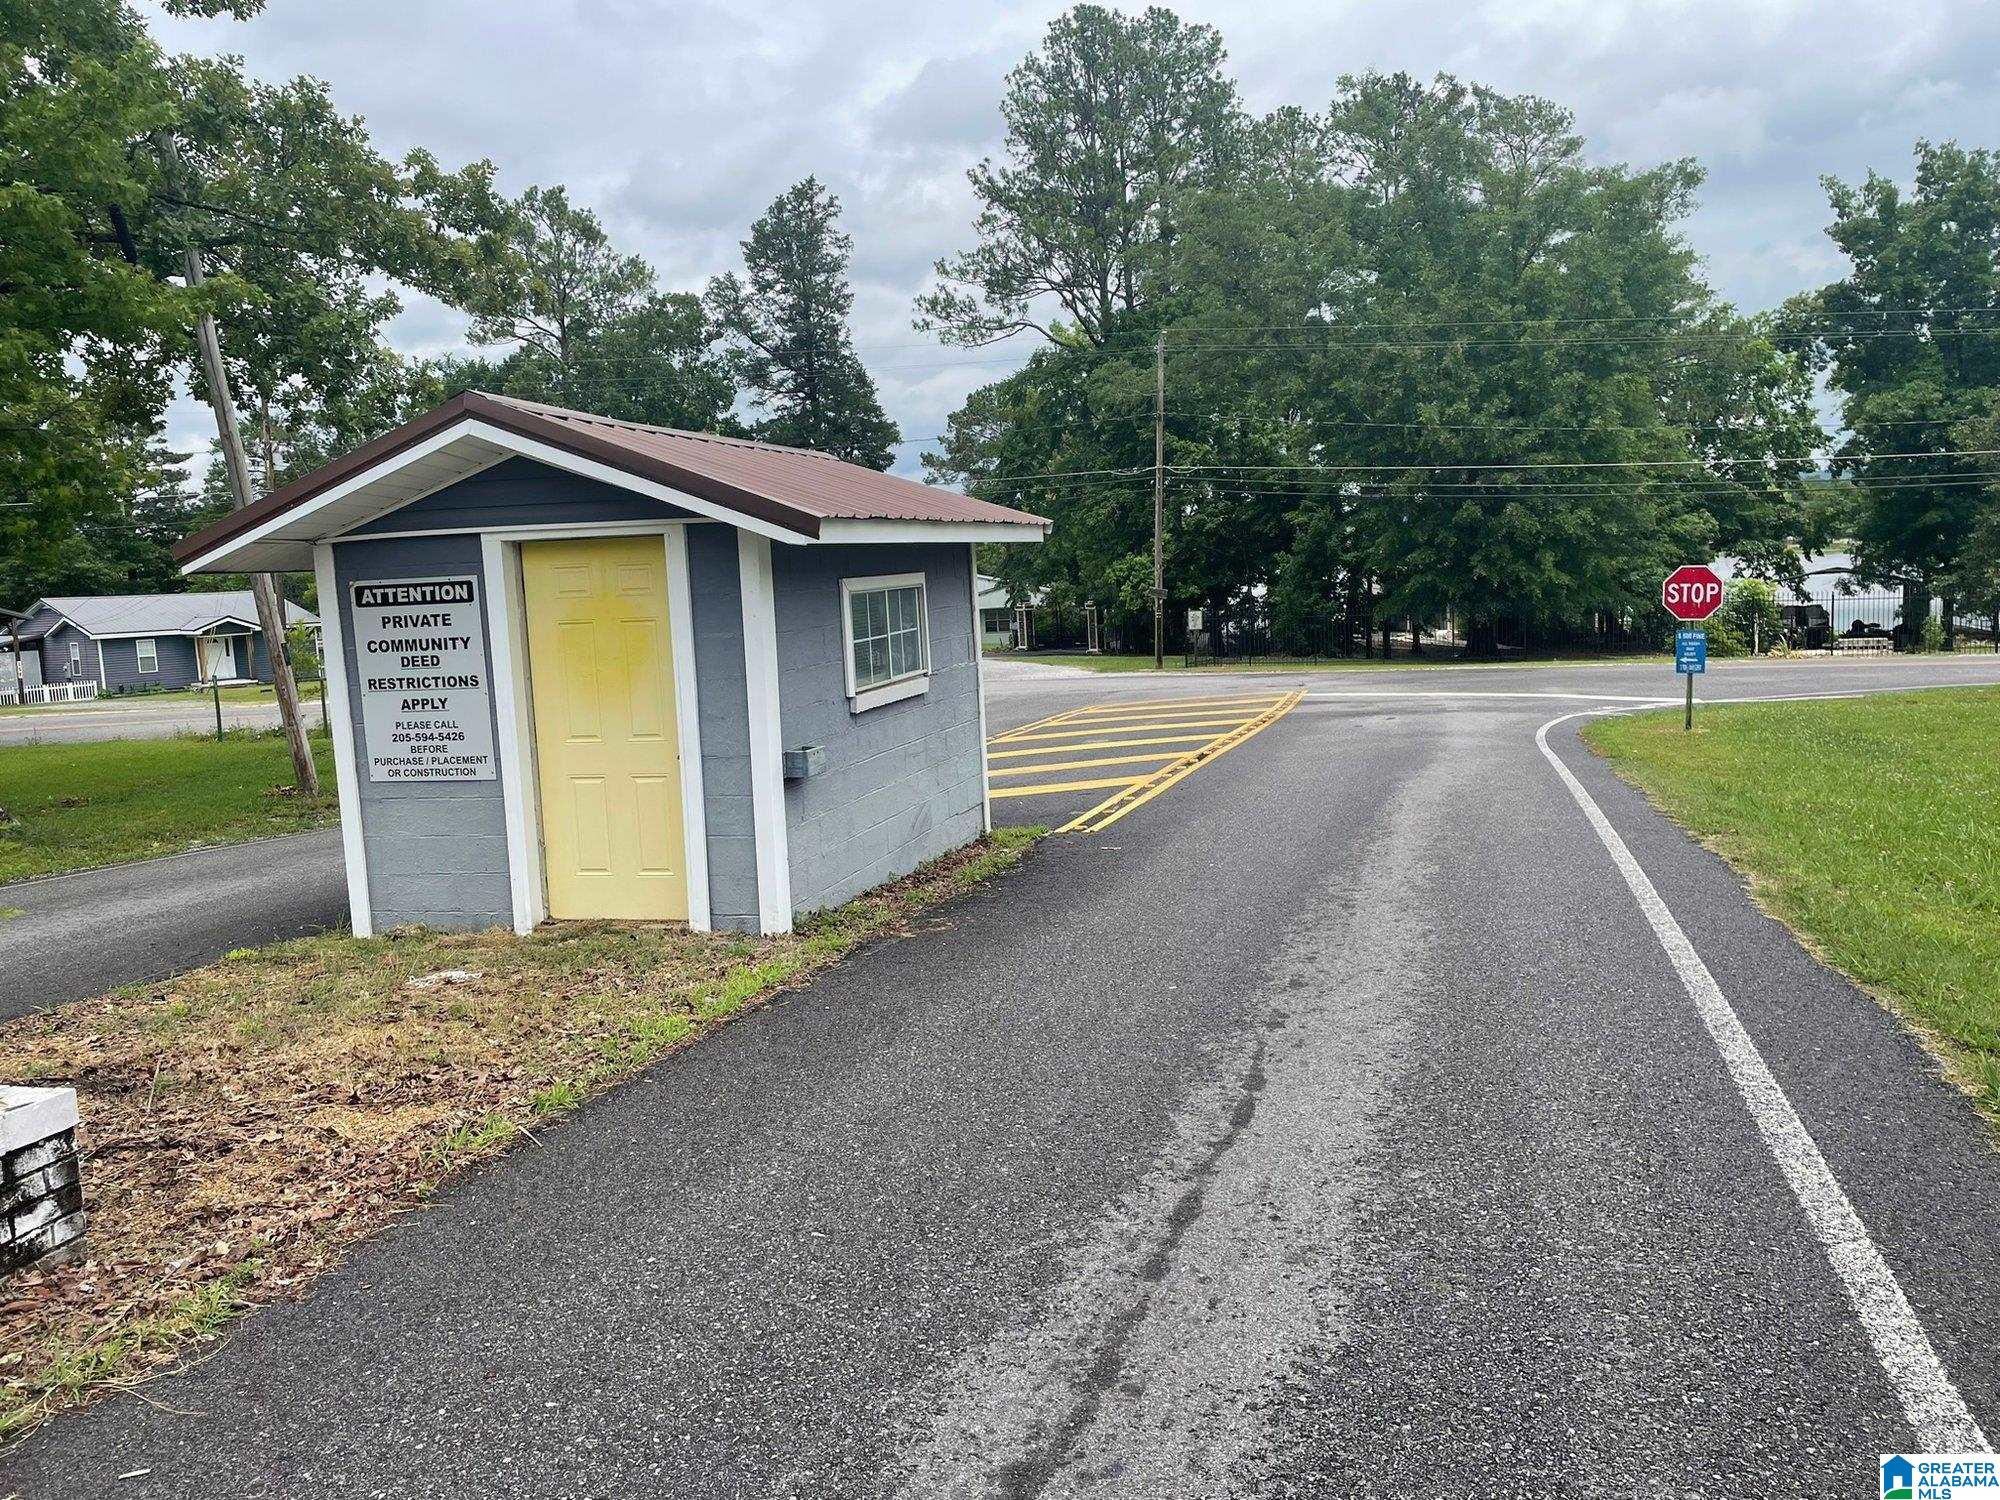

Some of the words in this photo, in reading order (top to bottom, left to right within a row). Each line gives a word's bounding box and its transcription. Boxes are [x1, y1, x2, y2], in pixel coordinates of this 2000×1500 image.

[361, 584, 469, 604] ATTENTION
[1667, 583, 1719, 604] STOP
[381, 613, 452, 629] PRIVATE
[367, 636, 471, 653] COMMUNITY
[401, 655, 440, 668] DEED
[368, 675, 479, 690] RESTRICTIONS
[401, 697, 448, 711] APPLY
[395, 721, 432, 730] PLEASE
[433, 720, 459, 729] CALL
[391, 731, 465, 743] 205-594-5426
[410, 745, 448, 754] BEFORE
[374, 757, 424, 766] PURCHASE
[431, 755, 488, 765] PLACEMENT
[387, 769, 401, 777] OR
[403, 768, 477, 777] CONSTRUCTION
